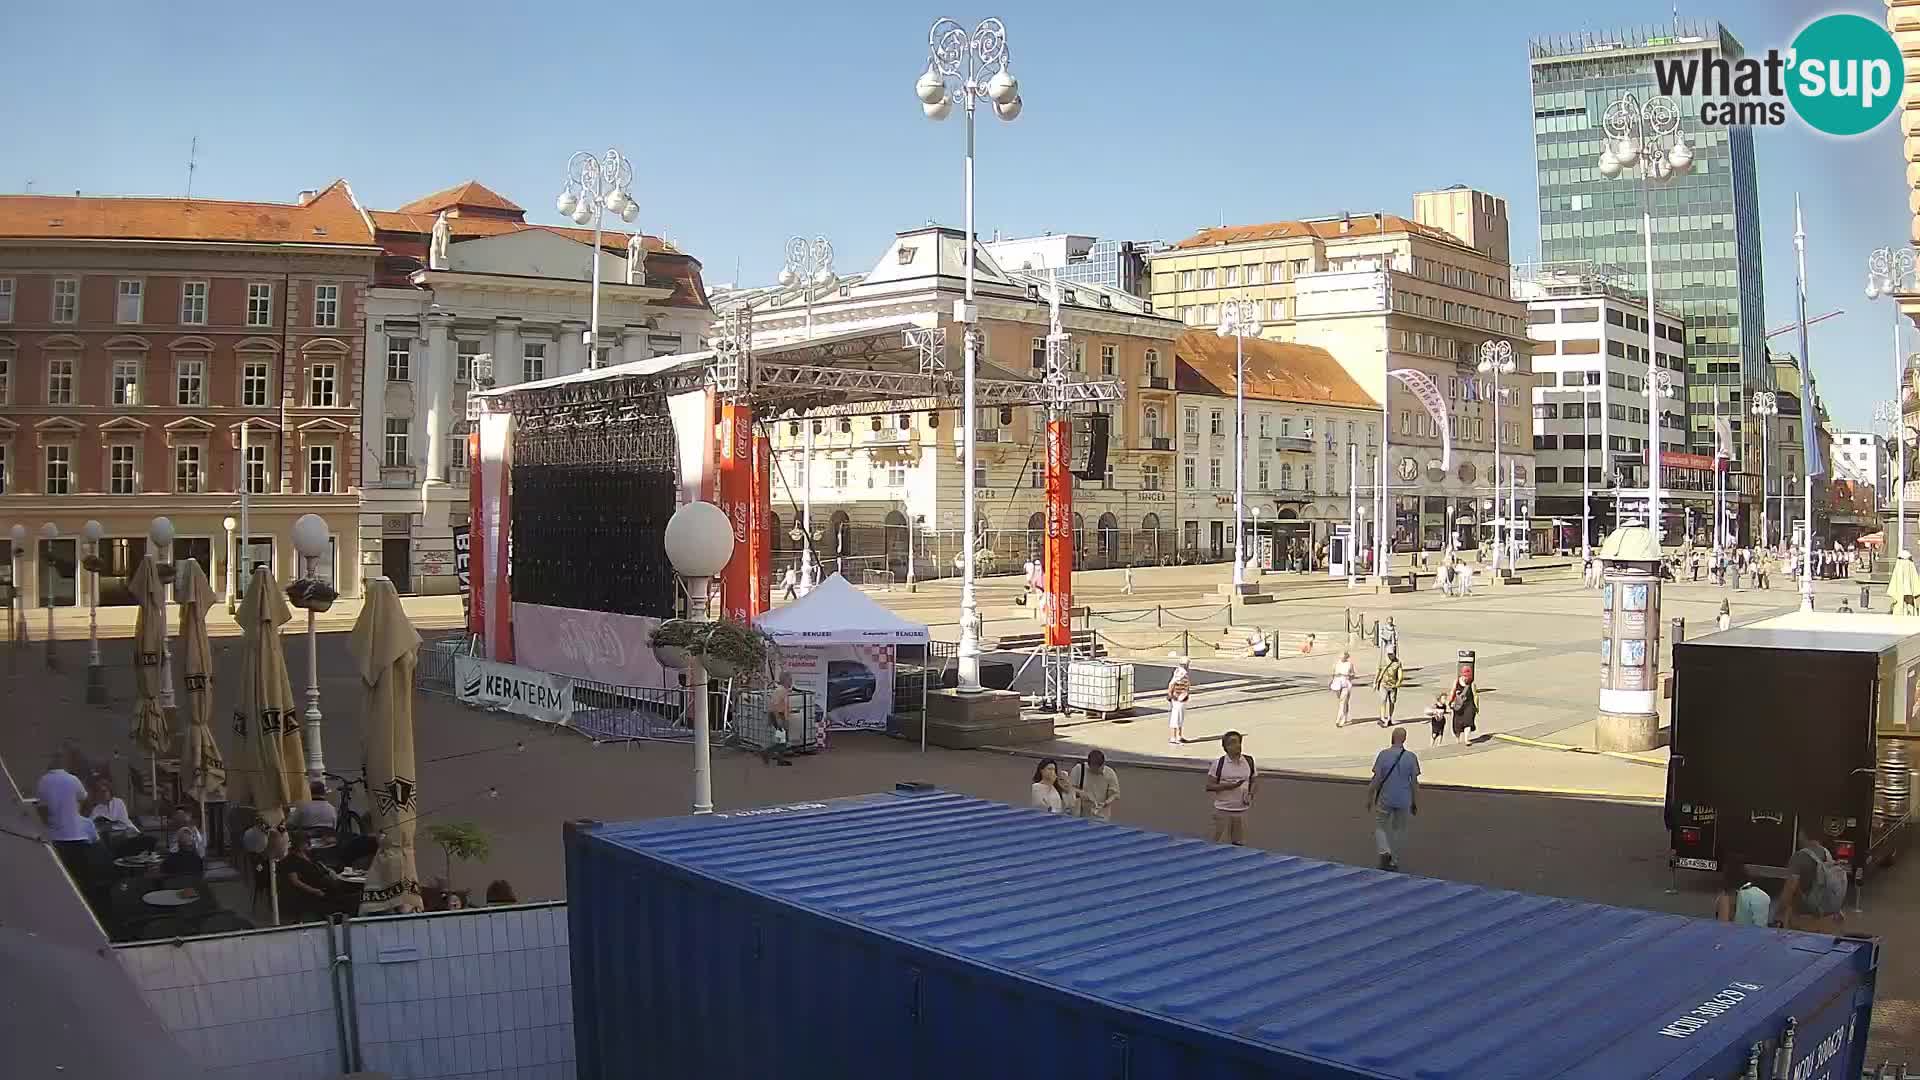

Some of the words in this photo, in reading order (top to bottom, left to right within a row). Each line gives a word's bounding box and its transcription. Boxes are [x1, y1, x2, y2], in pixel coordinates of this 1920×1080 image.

[961, 490, 996, 499] SGER
[1138, 492, 1166, 501] SINGER
[485, 675, 562, 711] KERATERM
[1658, 1015, 1709, 1038] MCDU
[1691, 989, 1747, 1018] 300629
[1733, 981, 1760, 991] 6
